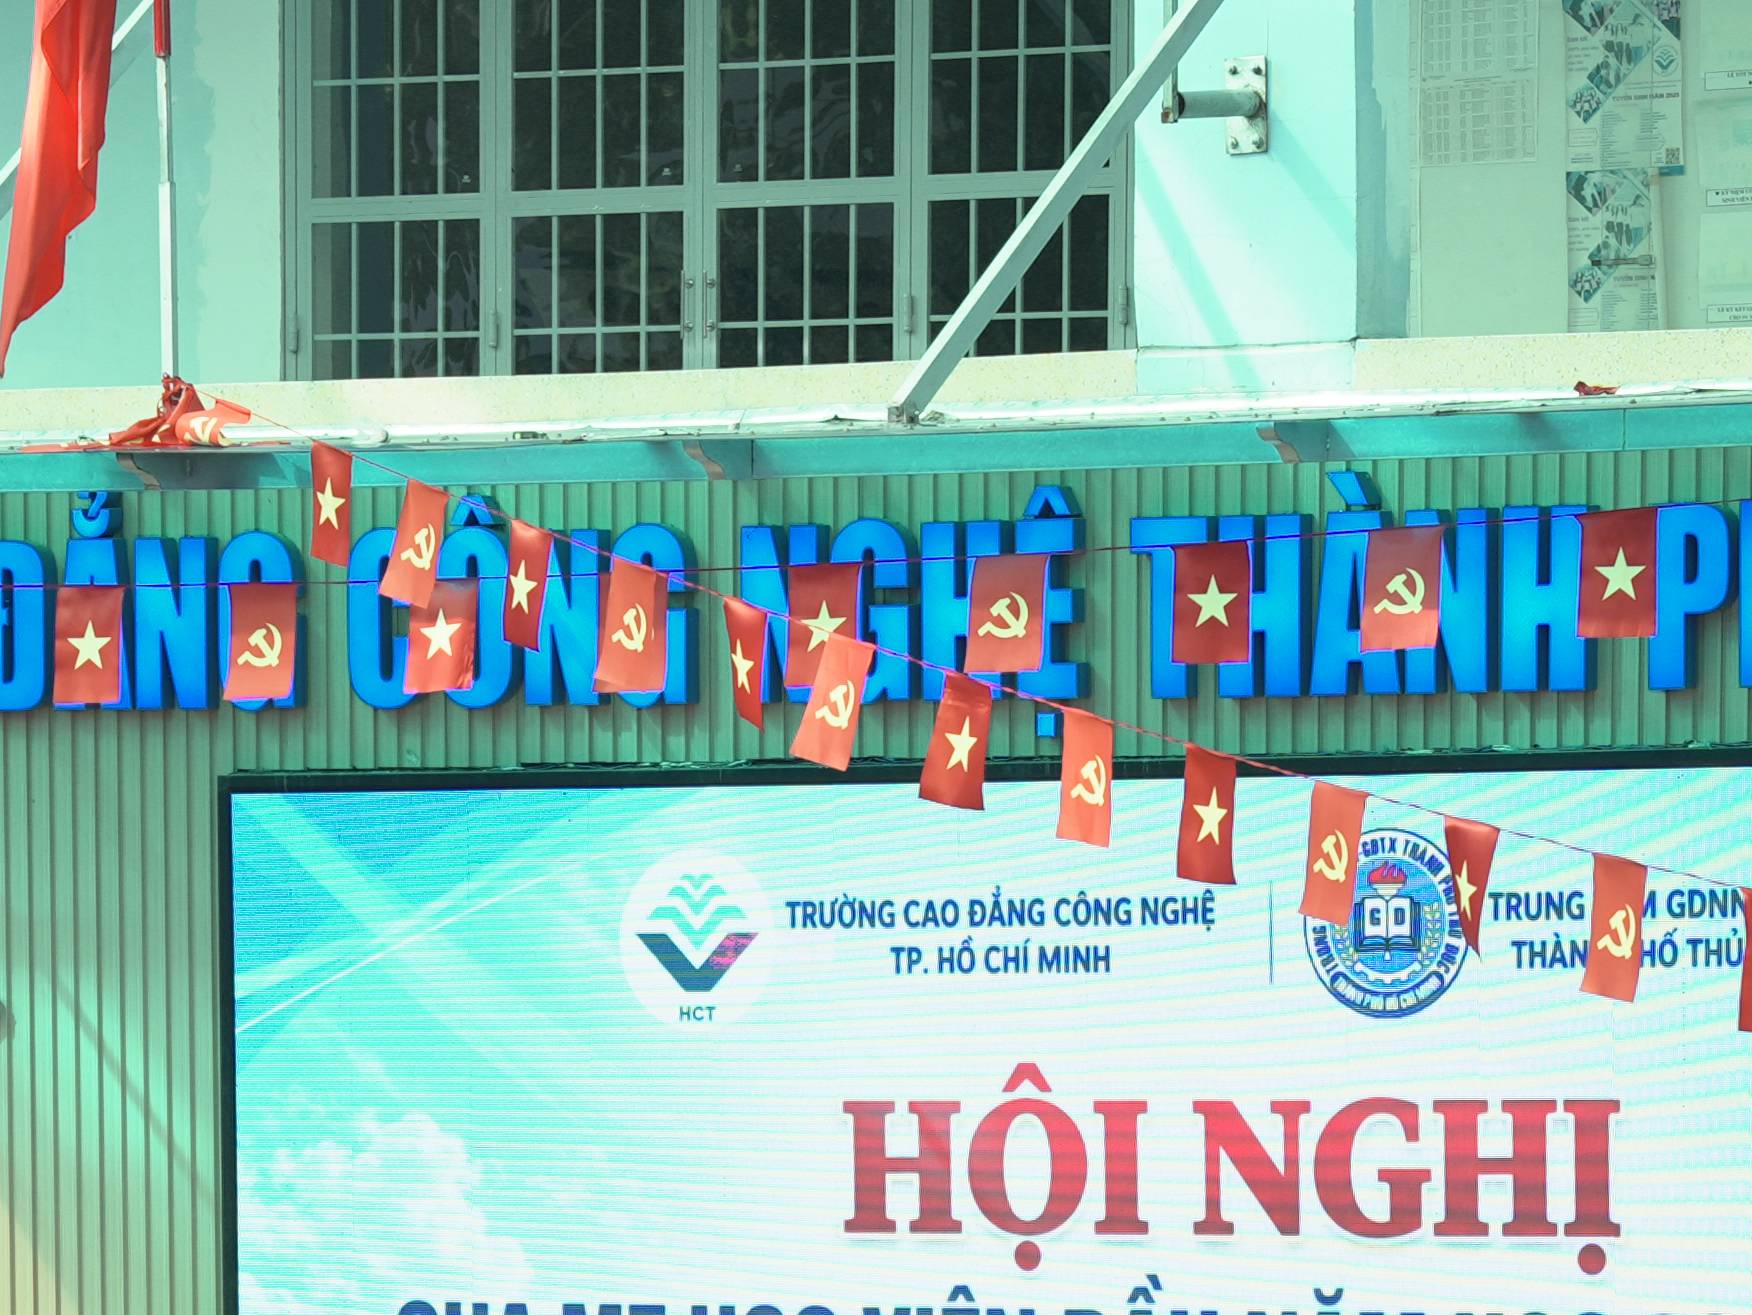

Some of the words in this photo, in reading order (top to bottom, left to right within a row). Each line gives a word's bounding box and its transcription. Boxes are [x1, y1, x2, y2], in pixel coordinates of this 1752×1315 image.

[1129, 471, 1596, 698] THÀNH
[785, 894, 895, 929] TRƯỜNG
[904, 900, 960, 929] CAO
[968, 885, 1045, 927] ĐẲNG
[1054, 890, 1132, 926] CÔNG
[1141, 888, 1216, 934] NGHỆ
[1488, 892, 1585, 921] TRUNG
[891, 946, 928, 974] TP.
[938, 935, 975, 974] HỒ
[984, 939, 1031, 974] CHÍ
[1039, 945, 1111, 973] MINH
[1686, 928, 1744, 968] THỦ
[679, 1006, 716, 1022] HCT
[842, 1062, 1149, 1273] HỘI
[1192, 1096, 1621, 1275] NGHỊ
